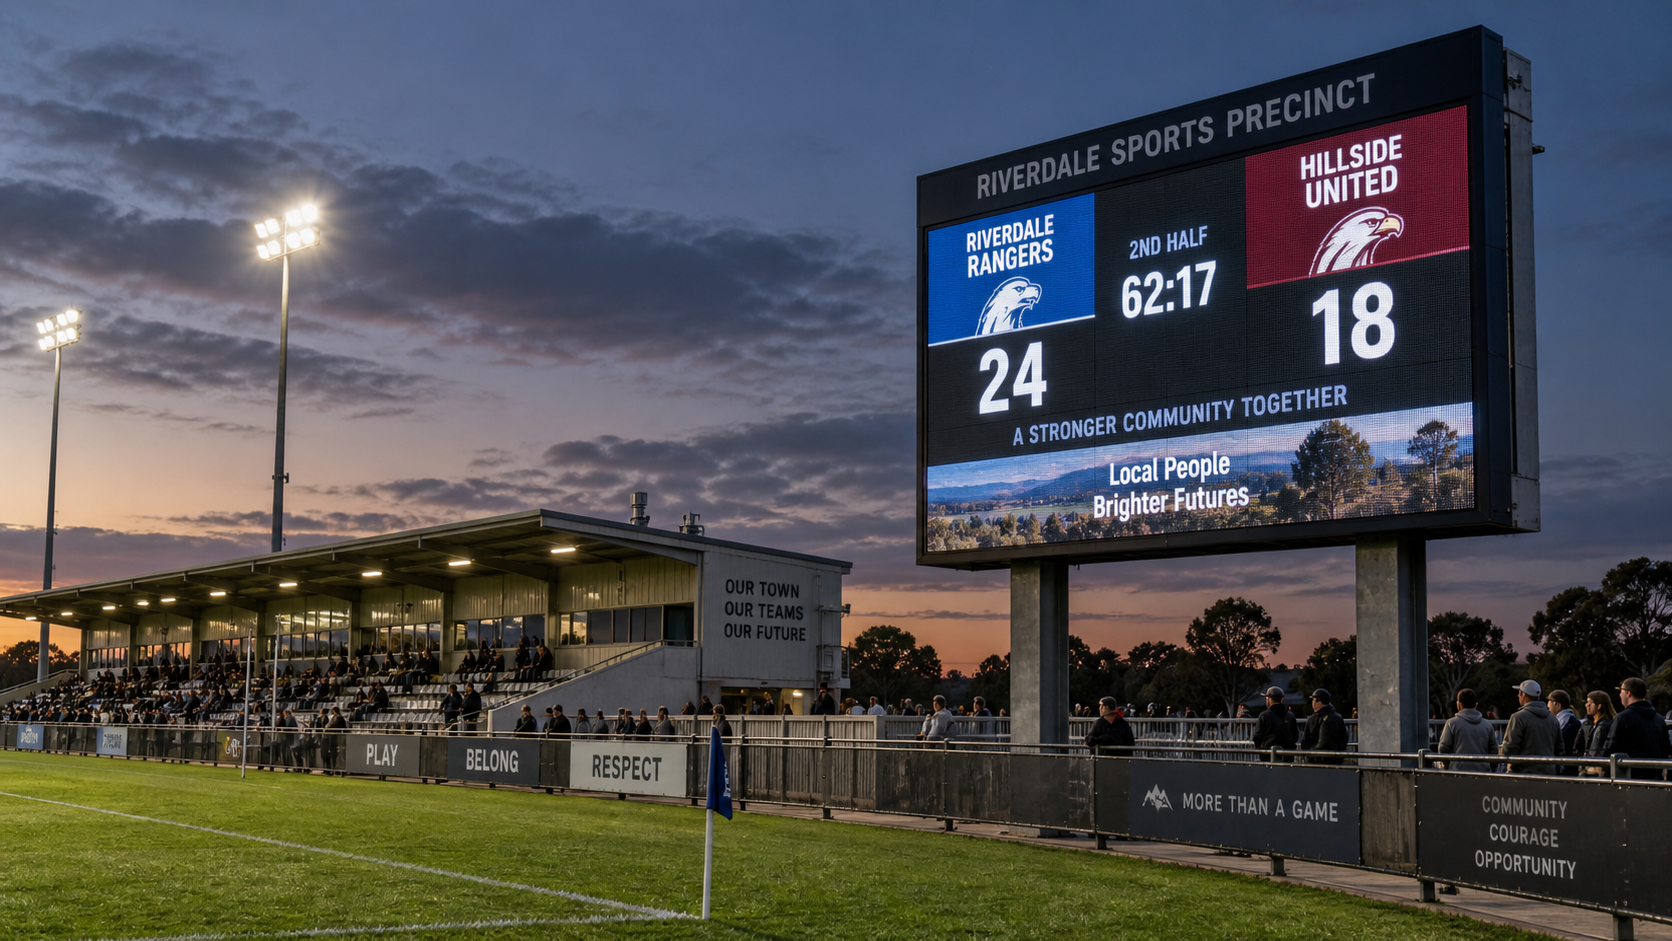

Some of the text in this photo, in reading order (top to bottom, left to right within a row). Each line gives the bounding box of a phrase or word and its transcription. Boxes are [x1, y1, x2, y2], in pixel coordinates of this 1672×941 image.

[977, 73, 1375, 199] RIVERDALE SPORTS PRECINCT
[1301, 134, 1402, 180] HILLSIDE
[1306, 165, 1398, 208] UNITED
[966, 214, 1054, 252] RIVERDALE
[1129, 225, 1208, 259] 2ND HALF
[967, 238, 1053, 278] RANGERS
[1121, 260, 1217, 319] 62:17
[1312, 281, 1396, 365] 18
[979, 341, 1047, 415] 24
[1013, 384, 1347, 446] A STRONGER COMMUNITY TOGETHER
[1109, 451, 1230, 486] Local People
[1093, 486, 1250, 522] Brighter Futures
[725, 579, 800, 598] OUR TOWN
[725, 601, 804, 620] OUR TEAMS
[724, 623, 806, 641] OUR FUTURE
[366, 743, 398, 767] PLAY
[466, 748, 519, 773] BELONG
[592, 754, 662, 782] RESPECT
[1183, 792, 1338, 822] MORE THAN A GAME
[1482, 796, 1567, 819] COMMUNITY
[1490, 824, 1558, 848] COURAGE
[1475, 849, 1576, 879] OPPORTUNITY
